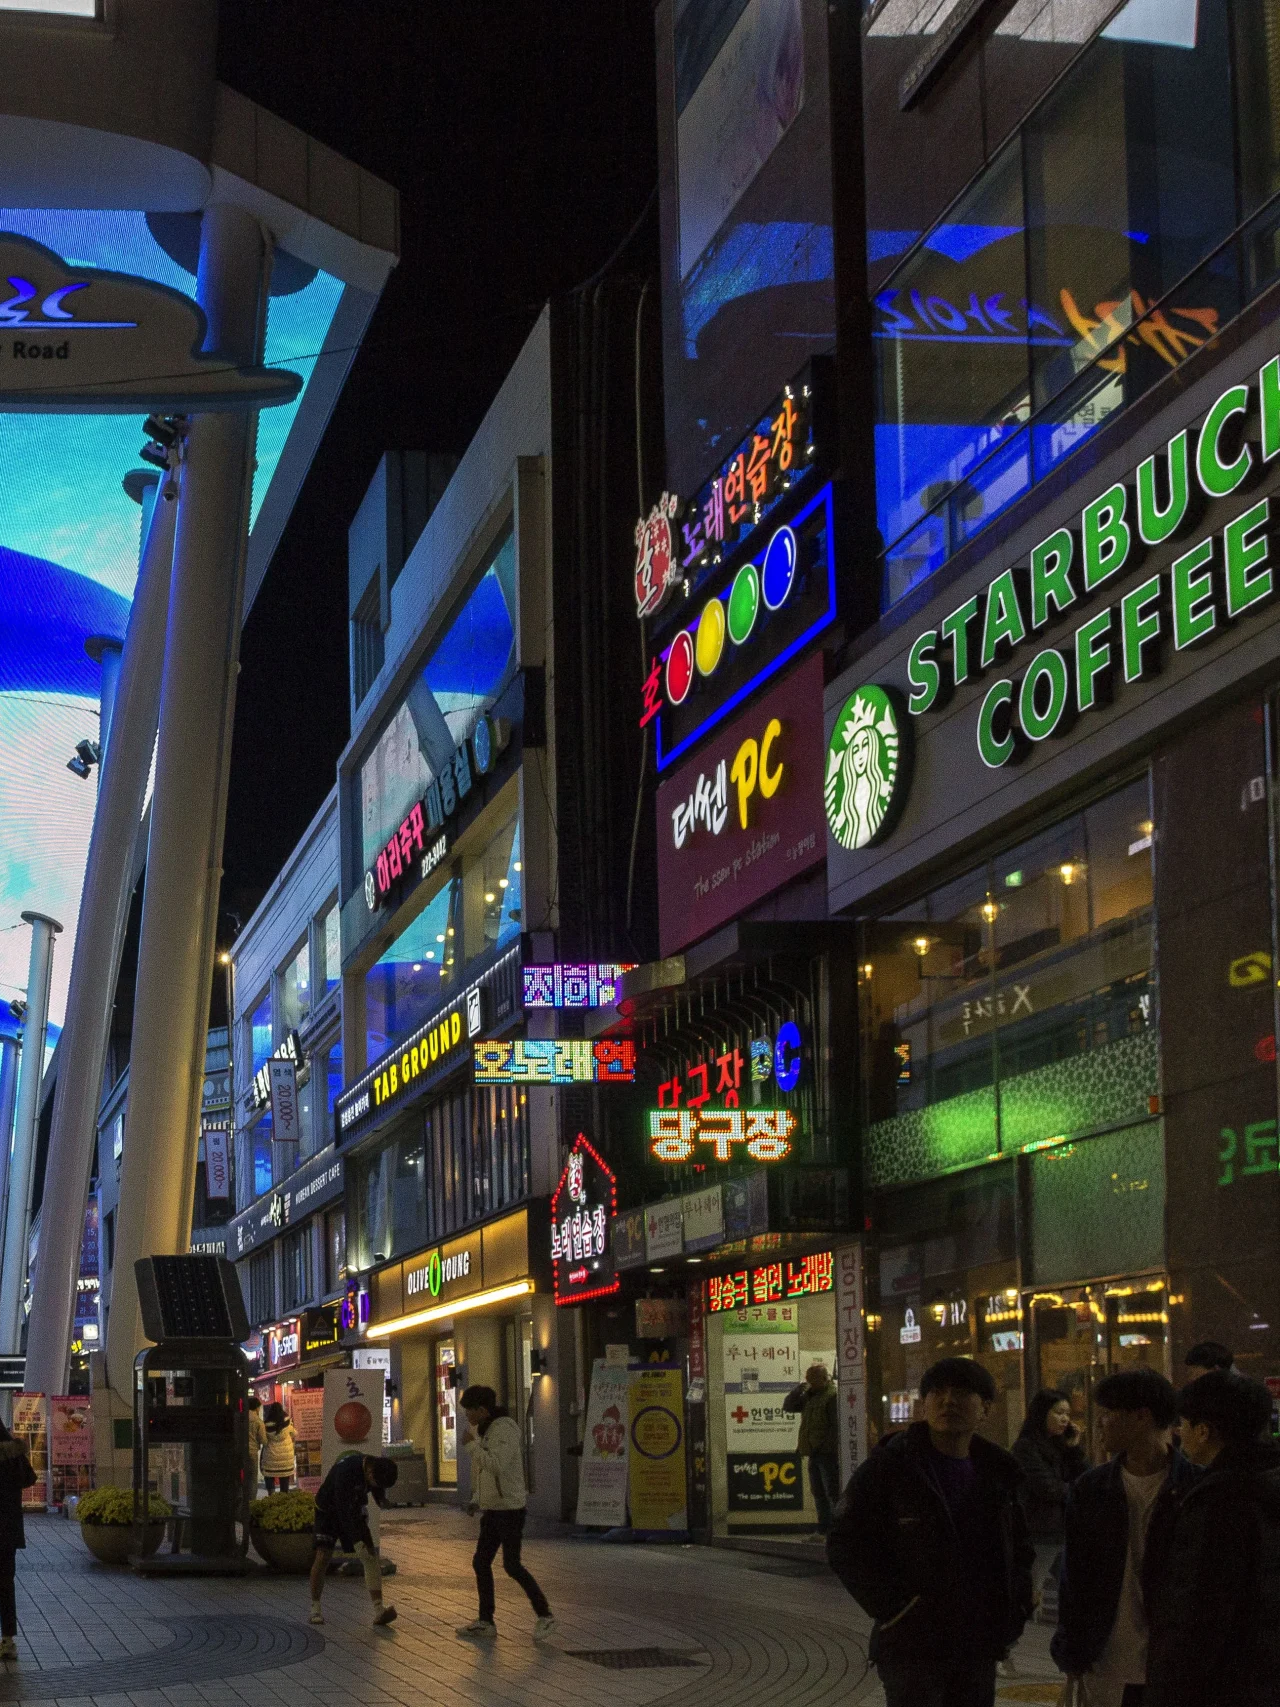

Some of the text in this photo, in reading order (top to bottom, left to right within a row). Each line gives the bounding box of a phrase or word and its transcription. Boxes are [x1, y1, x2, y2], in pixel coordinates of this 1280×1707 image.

[12, 338, 69, 360] Road
[682, 398, 799, 568] 노래연습장
[976, 497, 1274, 769] COFFEE
[730, 718, 784, 830] PC
[373, 1011, 462, 1106] TAB GROUND
[649, 1109, 797, 1162] 당구장
[328, 1162, 341, 1182] CAFE
[551, 1204, 606, 1262] 노래연습장
[407, 1251, 470, 1295] OLIVE YOUNG
[708, 1270, 749, 1311] 방송국
[787, 1251, 834, 1298] 노래방
[736, 1307, 793, 1322] 당구클럽
[841, 1252, 860, 1360] 당구장
[758, 1461, 797, 1493] PC
